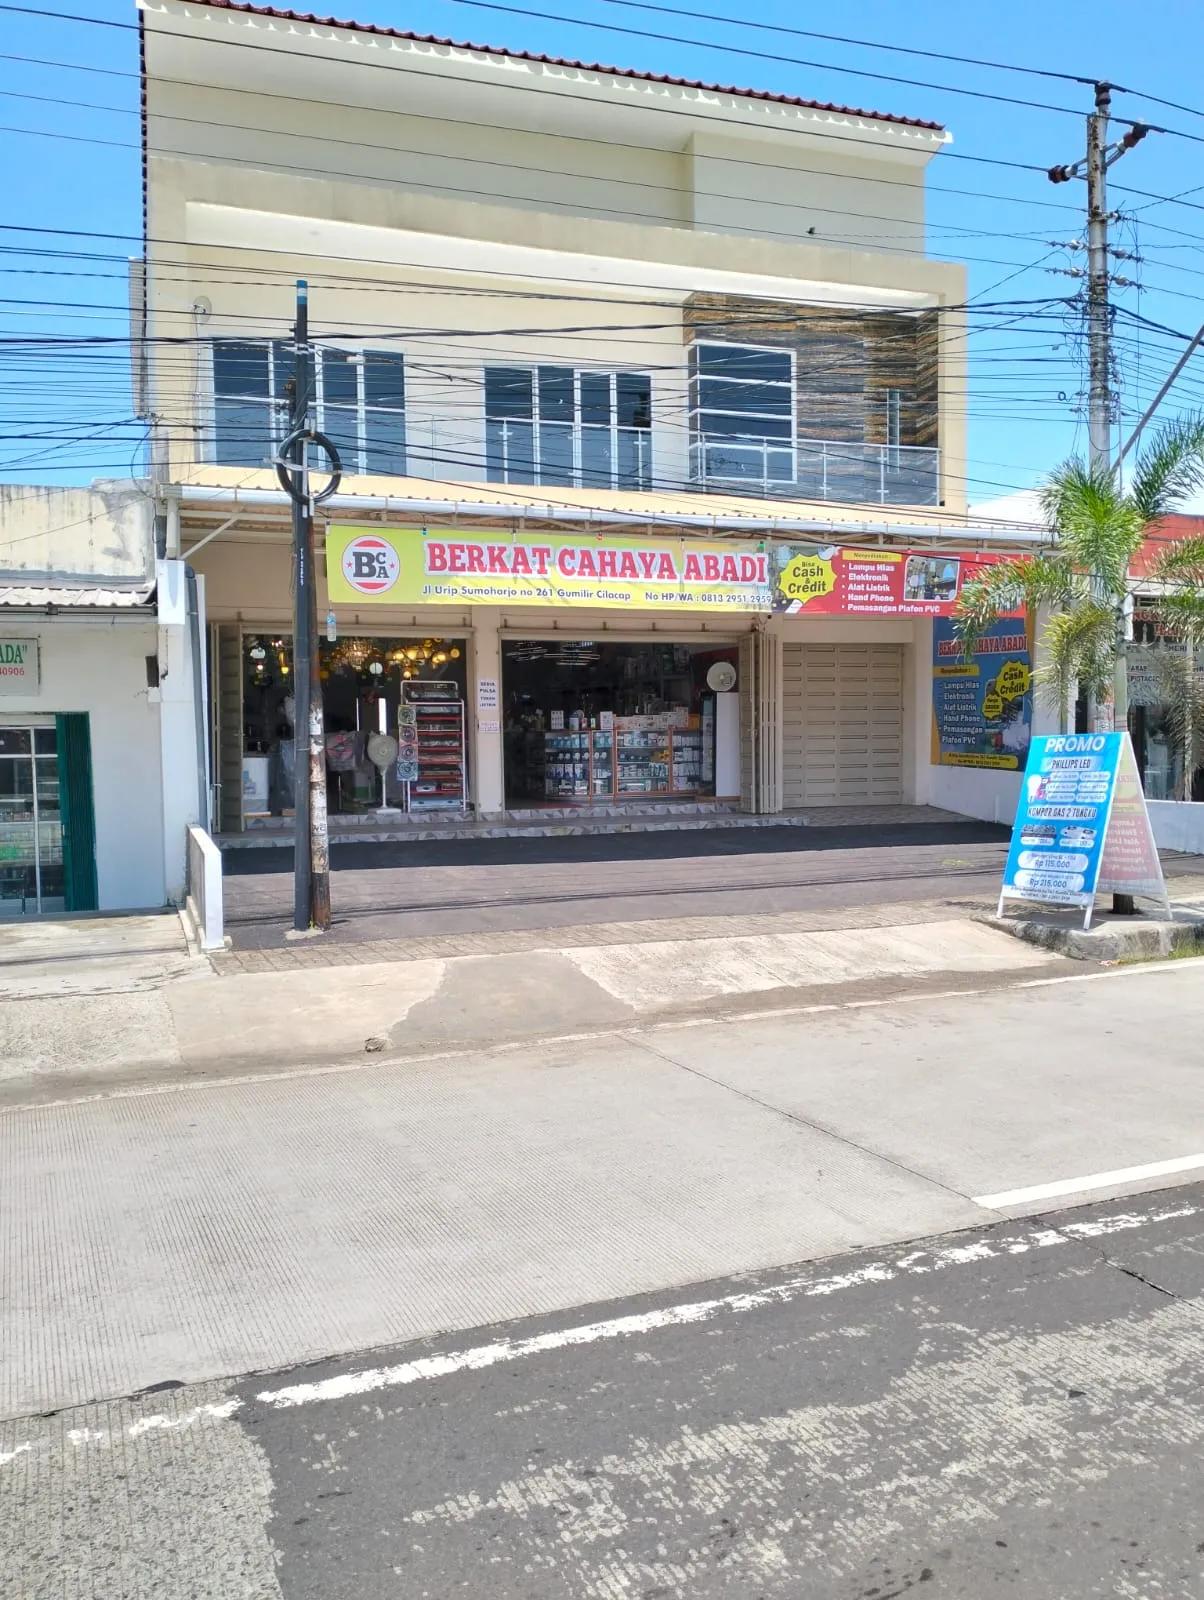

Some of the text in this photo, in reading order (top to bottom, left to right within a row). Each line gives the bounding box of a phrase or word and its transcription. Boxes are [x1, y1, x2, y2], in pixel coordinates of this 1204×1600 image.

[427, 543, 767, 583] BERKAT CAHAYA ABADI
[848, 563, 895, 572] Lampu Hias
[792, 566, 824, 577] Cash
[848, 573, 889, 581] Elektronik
[788, 581, 826, 594] Credit
[848, 583, 890, 592] Alat Listrik
[423, 586, 433, 594] Jl
[435, 586, 458, 596] Urip
[461, 586, 517, 598] Sumoharjo
[536, 588, 553, 597] 261
[557, 589, 593, 599] Gumilir
[596, 590, 631, 601] Cilacap
[645, 592, 659, 601] No
[661, 592, 693, 602] HP/WA
[701, 594, 723, 602] 0813
[726, 594, 746, 603] 2951
[870, 594, 895, 602] Phone
[847, 603, 897, 612] Pemasangan
[898, 604, 924, 612] Plafon
[0, 667, 24, 676] 0906
[1003, 670, 1023, 681] Cash
[1000, 683, 1025, 694] Credit
[963, 736, 976, 744] PVC
[1044, 736, 1106, 753] PROMO
[1051, 759, 1091, 769] PHILLIPS LED
[1028, 807, 1052, 817] KOMPOR
[1053, 808, 1065, 817] GAS
[1066, 808, 1072, 817] 2
[1029, 878, 1038, 887] Rp
